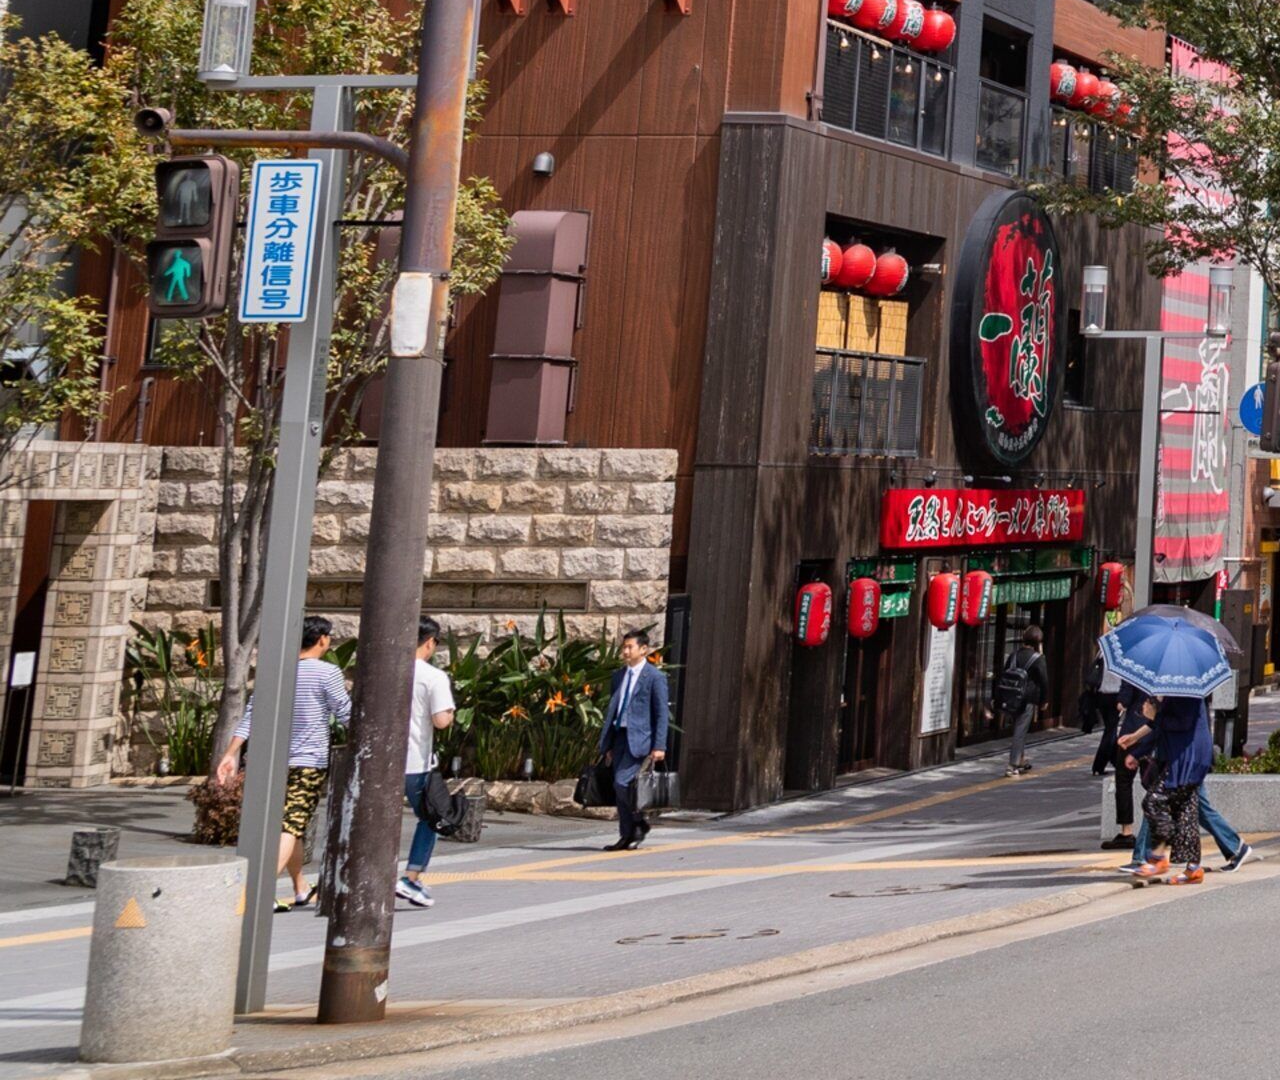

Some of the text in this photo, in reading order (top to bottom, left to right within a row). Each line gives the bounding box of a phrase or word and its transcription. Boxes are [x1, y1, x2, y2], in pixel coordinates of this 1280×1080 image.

[260, 170, 304, 310] 歩車分離信号
